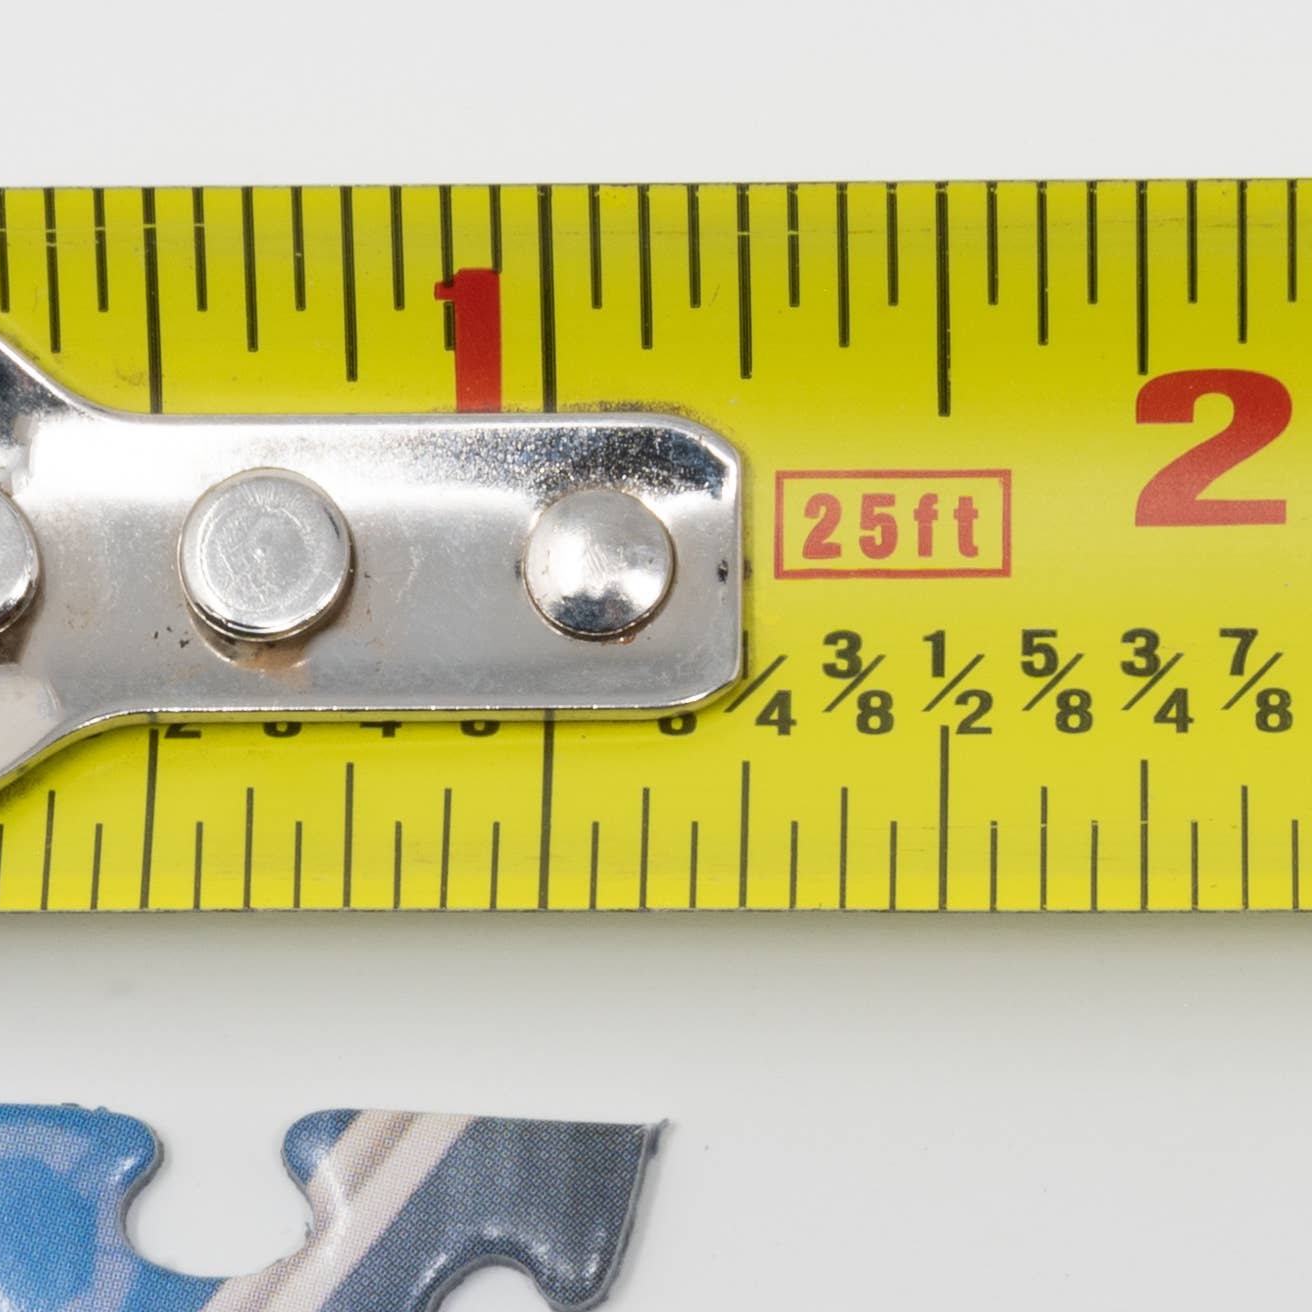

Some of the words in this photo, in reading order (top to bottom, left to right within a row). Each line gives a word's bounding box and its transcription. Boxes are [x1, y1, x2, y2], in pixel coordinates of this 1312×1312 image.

[434, 268, 502, 413] 1
[1135, 369, 1292, 527] 2
[802, 493, 979, 560] 25ft
